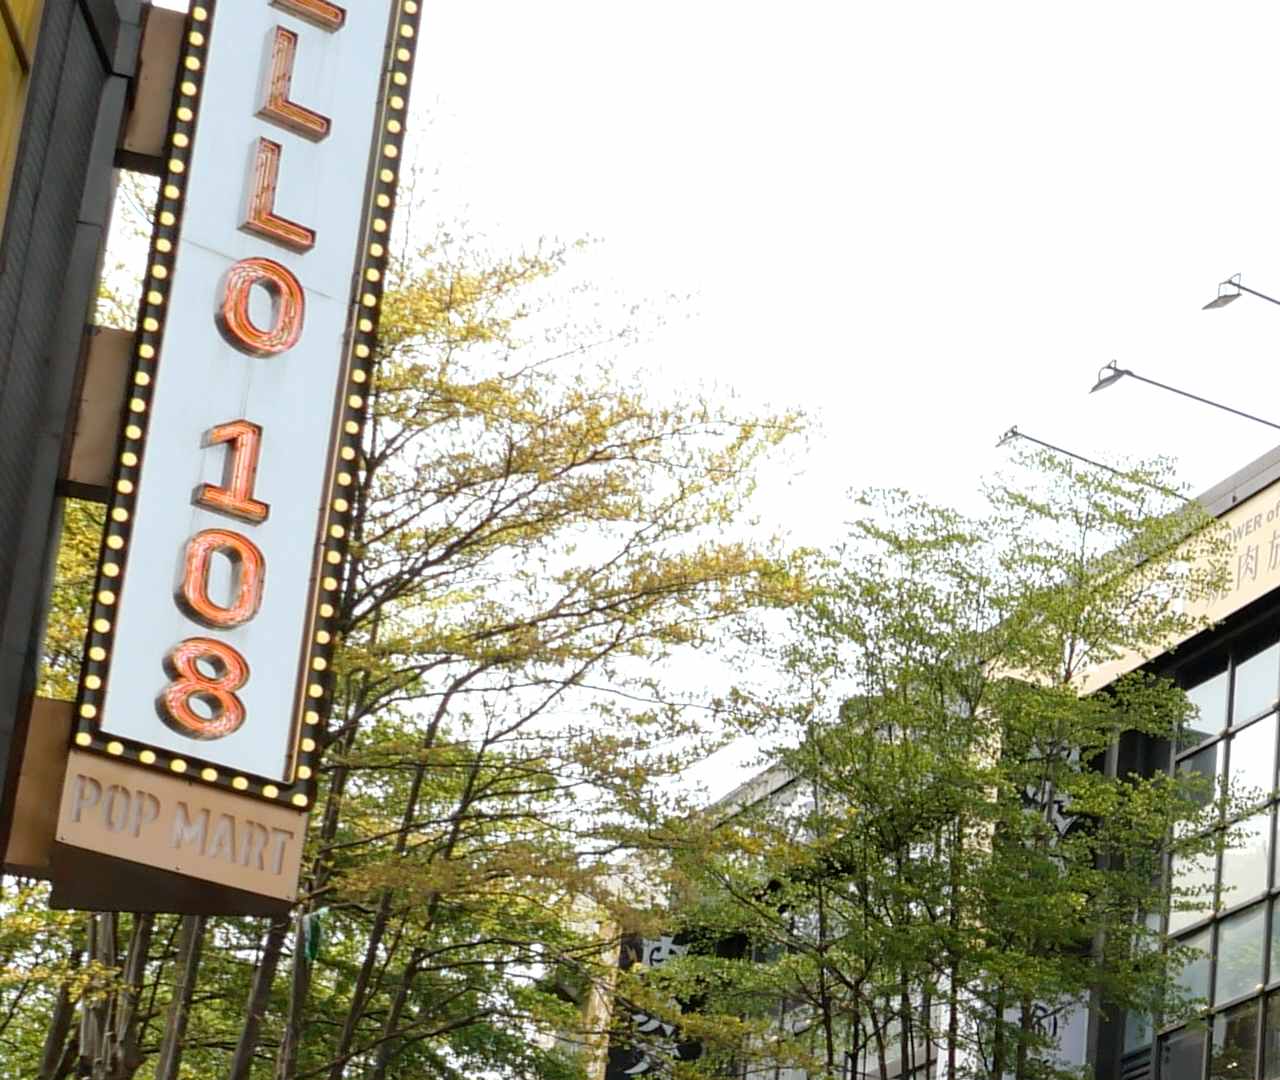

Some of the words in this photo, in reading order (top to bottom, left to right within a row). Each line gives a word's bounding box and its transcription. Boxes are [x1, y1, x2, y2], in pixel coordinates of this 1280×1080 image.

[155, 420, 271, 741] 108
[70, 773, 160, 838] POP
[169, 800, 295, 876] MART
